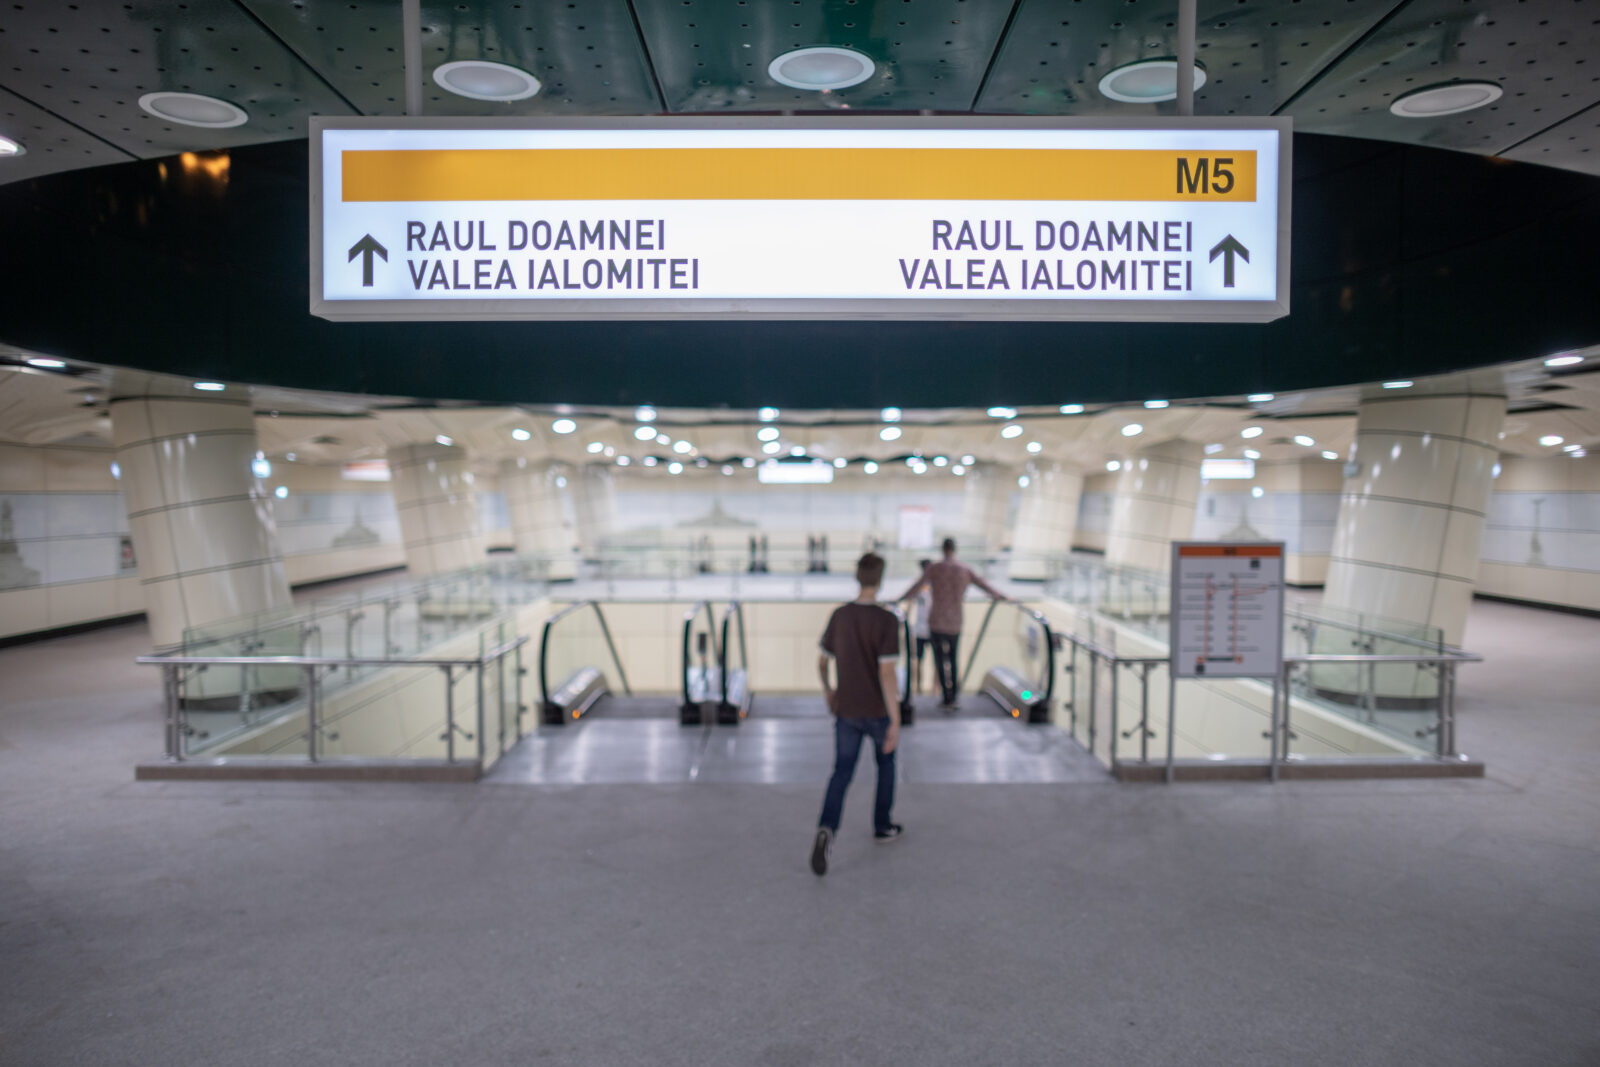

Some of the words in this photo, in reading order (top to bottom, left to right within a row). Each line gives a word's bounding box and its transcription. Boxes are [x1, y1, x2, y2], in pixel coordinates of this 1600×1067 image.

[1176, 157, 1234, 194] M5
[406, 220, 497, 252] RAUL
[508, 219, 665, 251] DOAMNEI
[932, 219, 1024, 251] RAUL
[1035, 220, 1193, 252] DOAMNEI
[407, 259, 517, 290] VALEA
[528, 258, 699, 290] IALOMITEI
[898, 258, 1010, 290] VALEA
[1022, 259, 1192, 291] IALOMITEI
